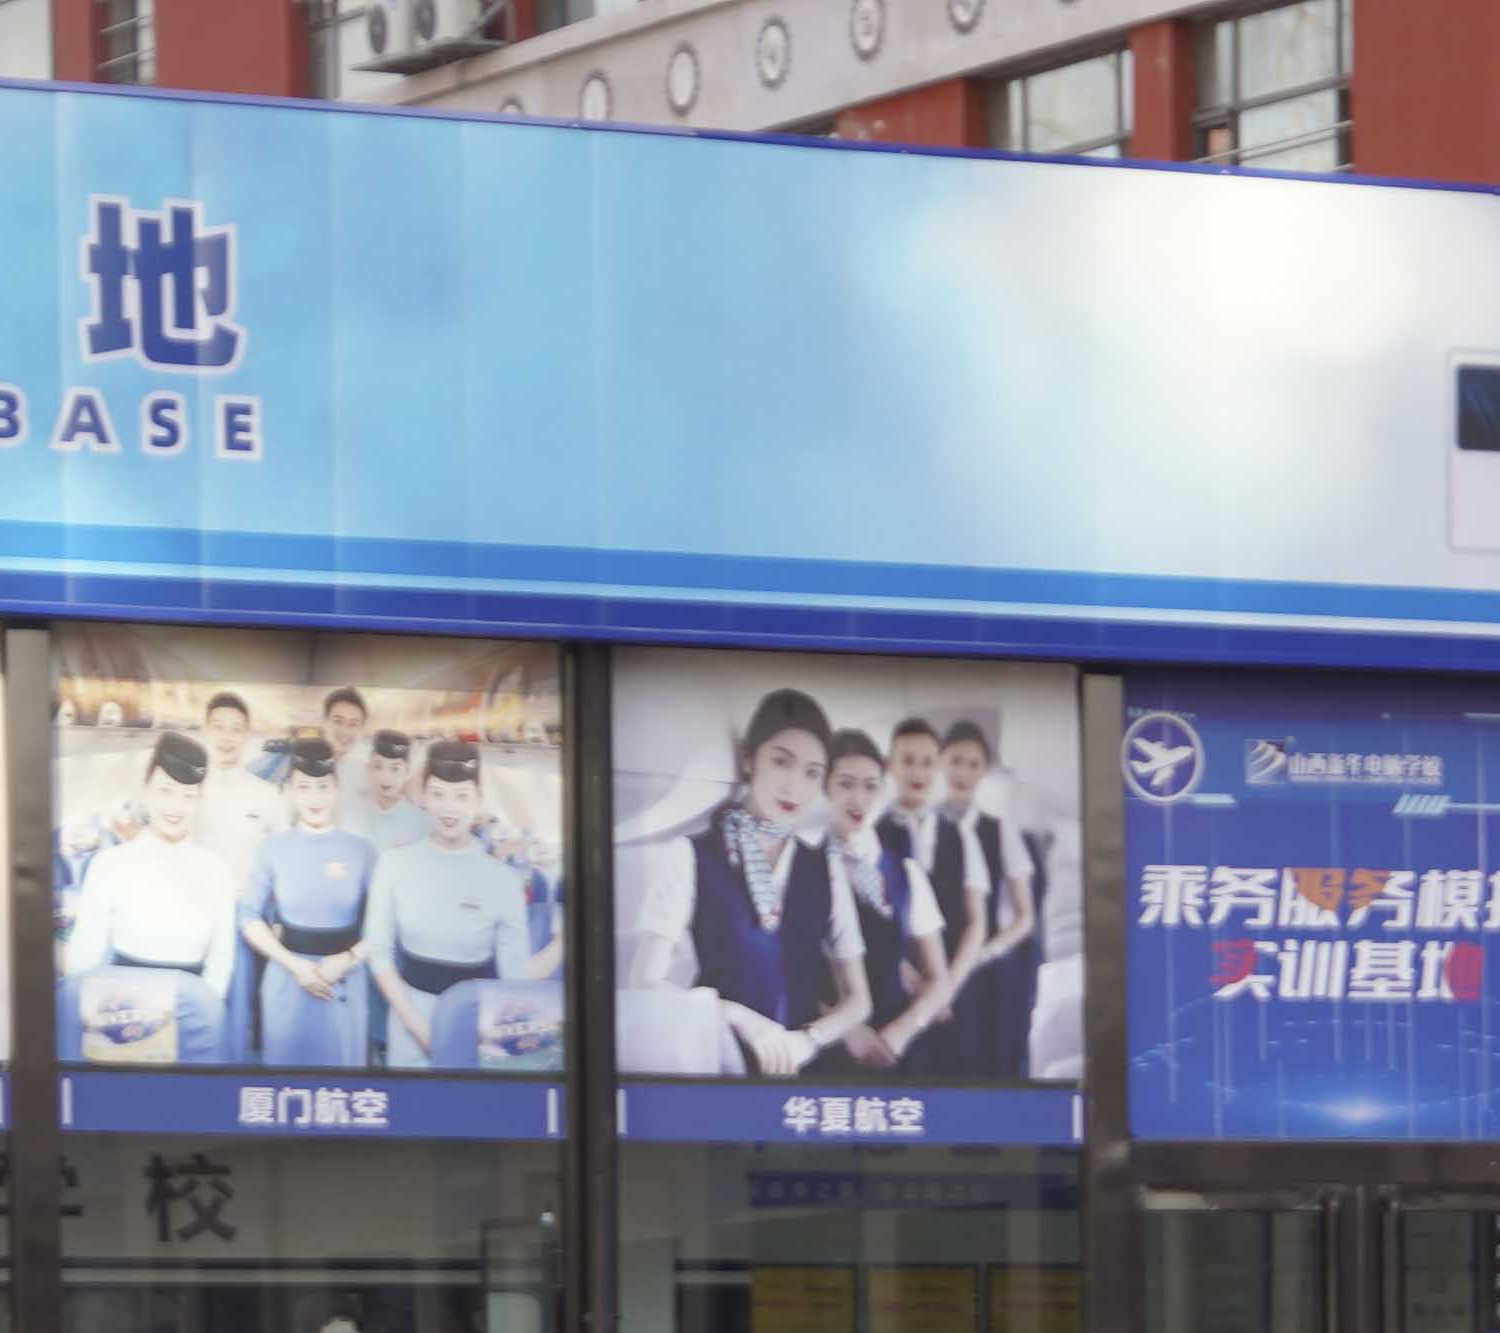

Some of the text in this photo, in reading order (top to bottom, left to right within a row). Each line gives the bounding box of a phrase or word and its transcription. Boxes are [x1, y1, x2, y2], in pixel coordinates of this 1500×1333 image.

[1210, 939, 1485, 1002] 实训基地
[239, 1086, 389, 1128] 厦门航空
[782, 1094, 925, 1135] 华夏航空
